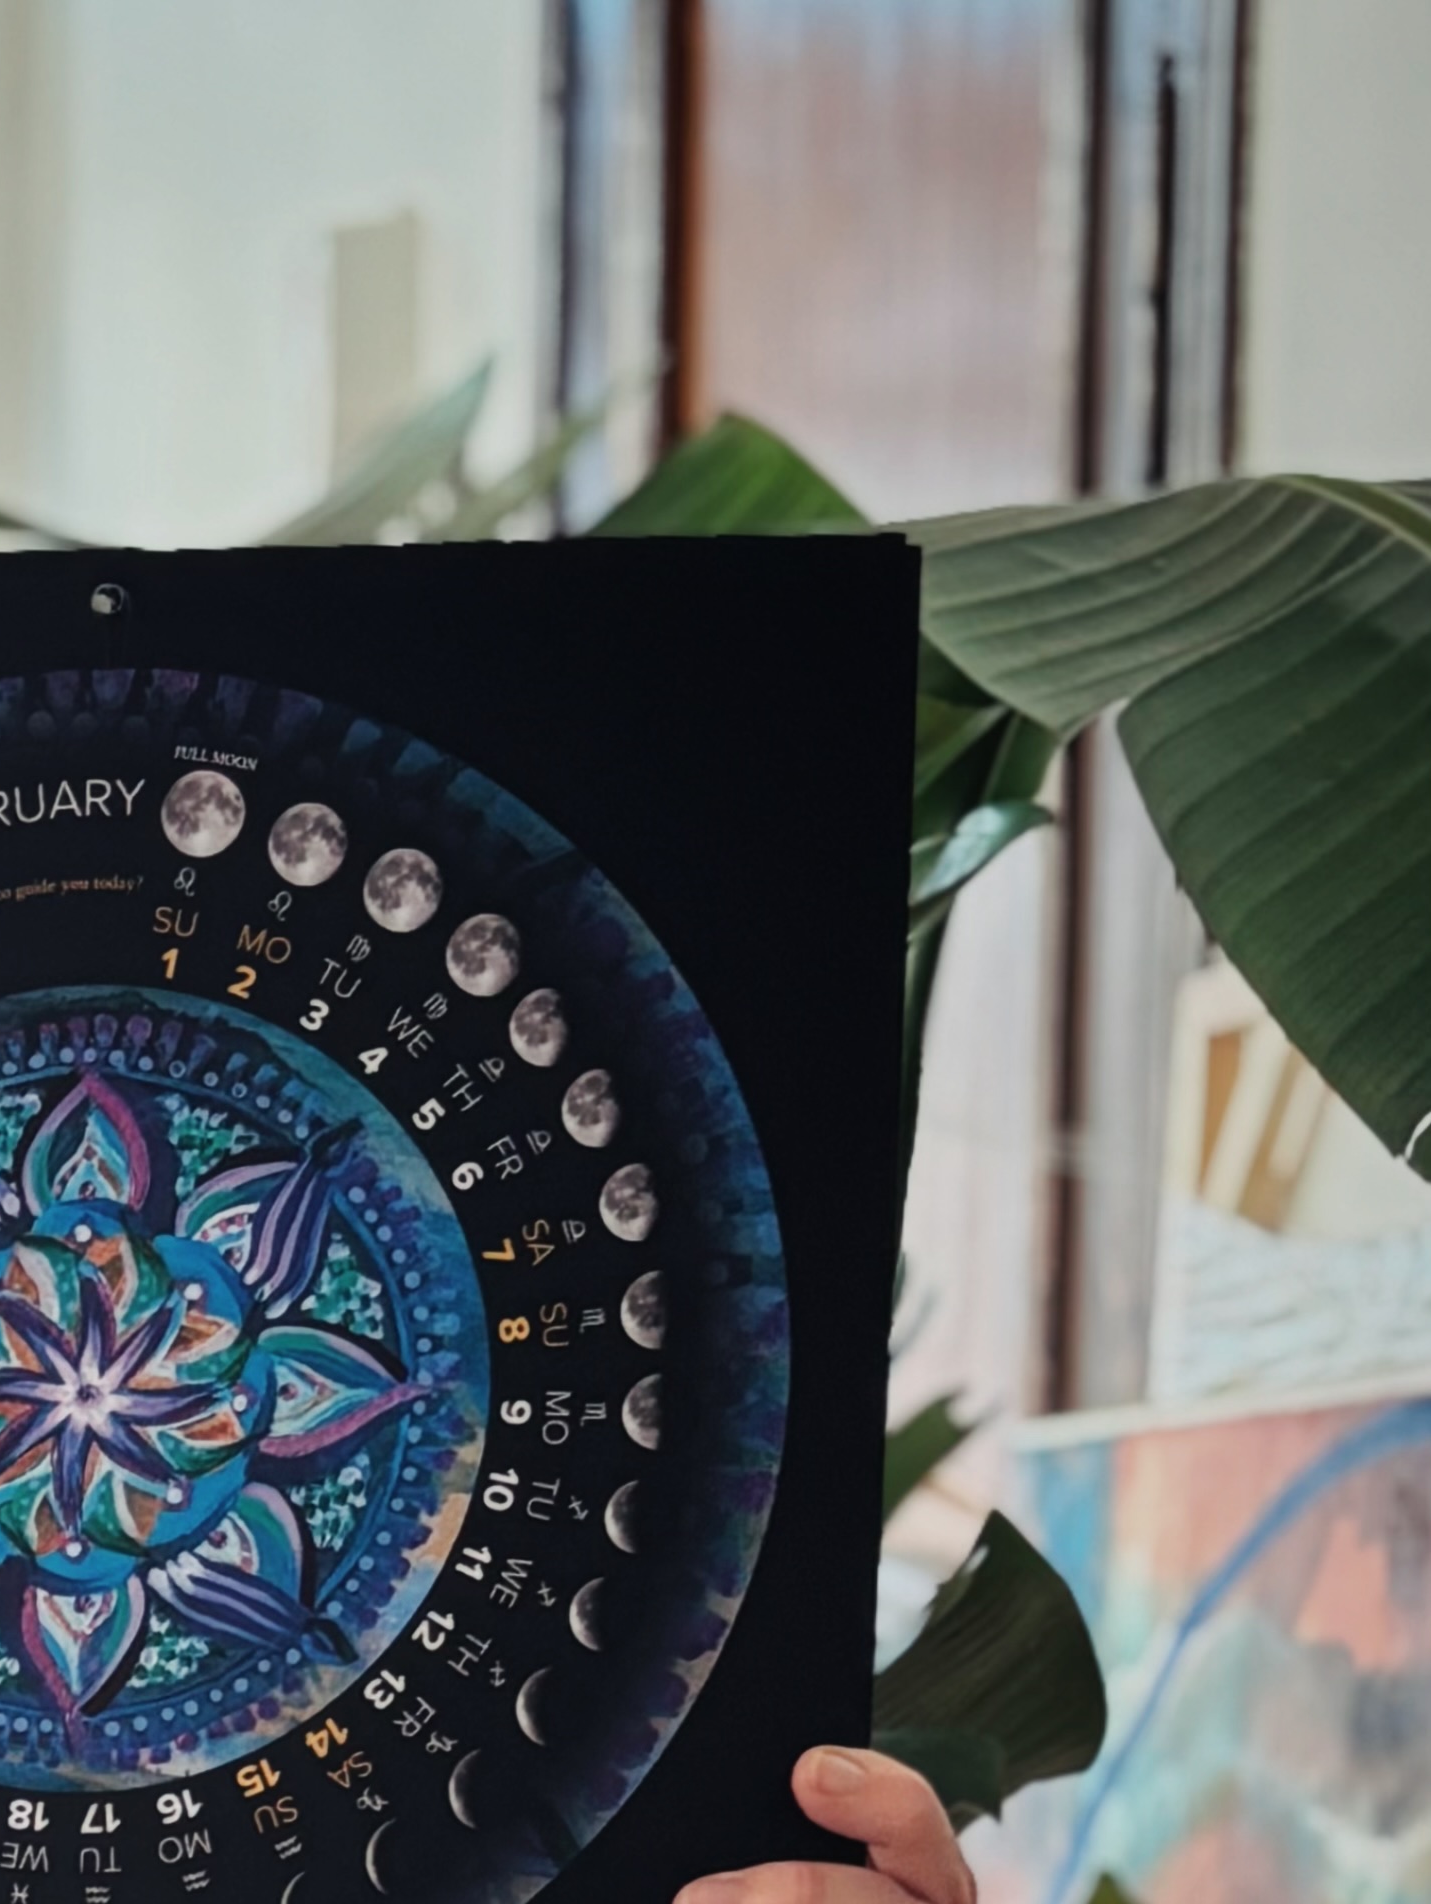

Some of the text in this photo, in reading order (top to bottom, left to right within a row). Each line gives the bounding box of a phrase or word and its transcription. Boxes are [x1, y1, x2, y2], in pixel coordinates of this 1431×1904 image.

[61, 880, 89, 895] you
[153, 906, 198, 937] SU
[237, 924, 291, 964] MO
[162, 948, 178, 979] 1
[227, 965, 256, 999] 2
[320, 958, 361, 998] TU
[300, 999, 329, 1030] 3
[387, 1003, 437, 1058] WE
[358, 1047, 388, 1074] 4
[443, 1063, 486, 1111] TH
[412, 1098, 445, 1130] 5
[452, 1162, 483, 1190] 6
[487, 1136, 523, 1179] FR
[483, 1238, 515, 1260] 7
[522, 1219, 555, 1265] SA
[499, 1317, 530, 1343] 8
[540, 1303, 569, 1347] SU
[500, 1400, 531, 1424] 9
[542, 1391, 571, 1445] MO
[483, 1469, 519, 1511] 10
[526, 1479, 560, 1520] TU
[455, 1547, 491, 1580] 11
[490, 1559, 533, 1608] WE
[412, 1611, 454, 1651] 12
[448, 1634, 492, 1676] TH
[364, 1670, 405, 1709] 13
[393, 1697, 437, 1740] FR
[306, 1718, 348, 1758] 14
[237, 1759, 280, 1797] 15
[327, 1751, 372, 1788] SA
[8, 1799, 49, 1831] 18
[81, 1803, 121, 1834] 17
[157, 1789, 202, 1824] 16
[254, 1796, 298, 1833] SU
[0, 1842, 48, 1872] WE
[80, 1847, 121, 1872] TU
[159, 1829, 212, 1863] MO
